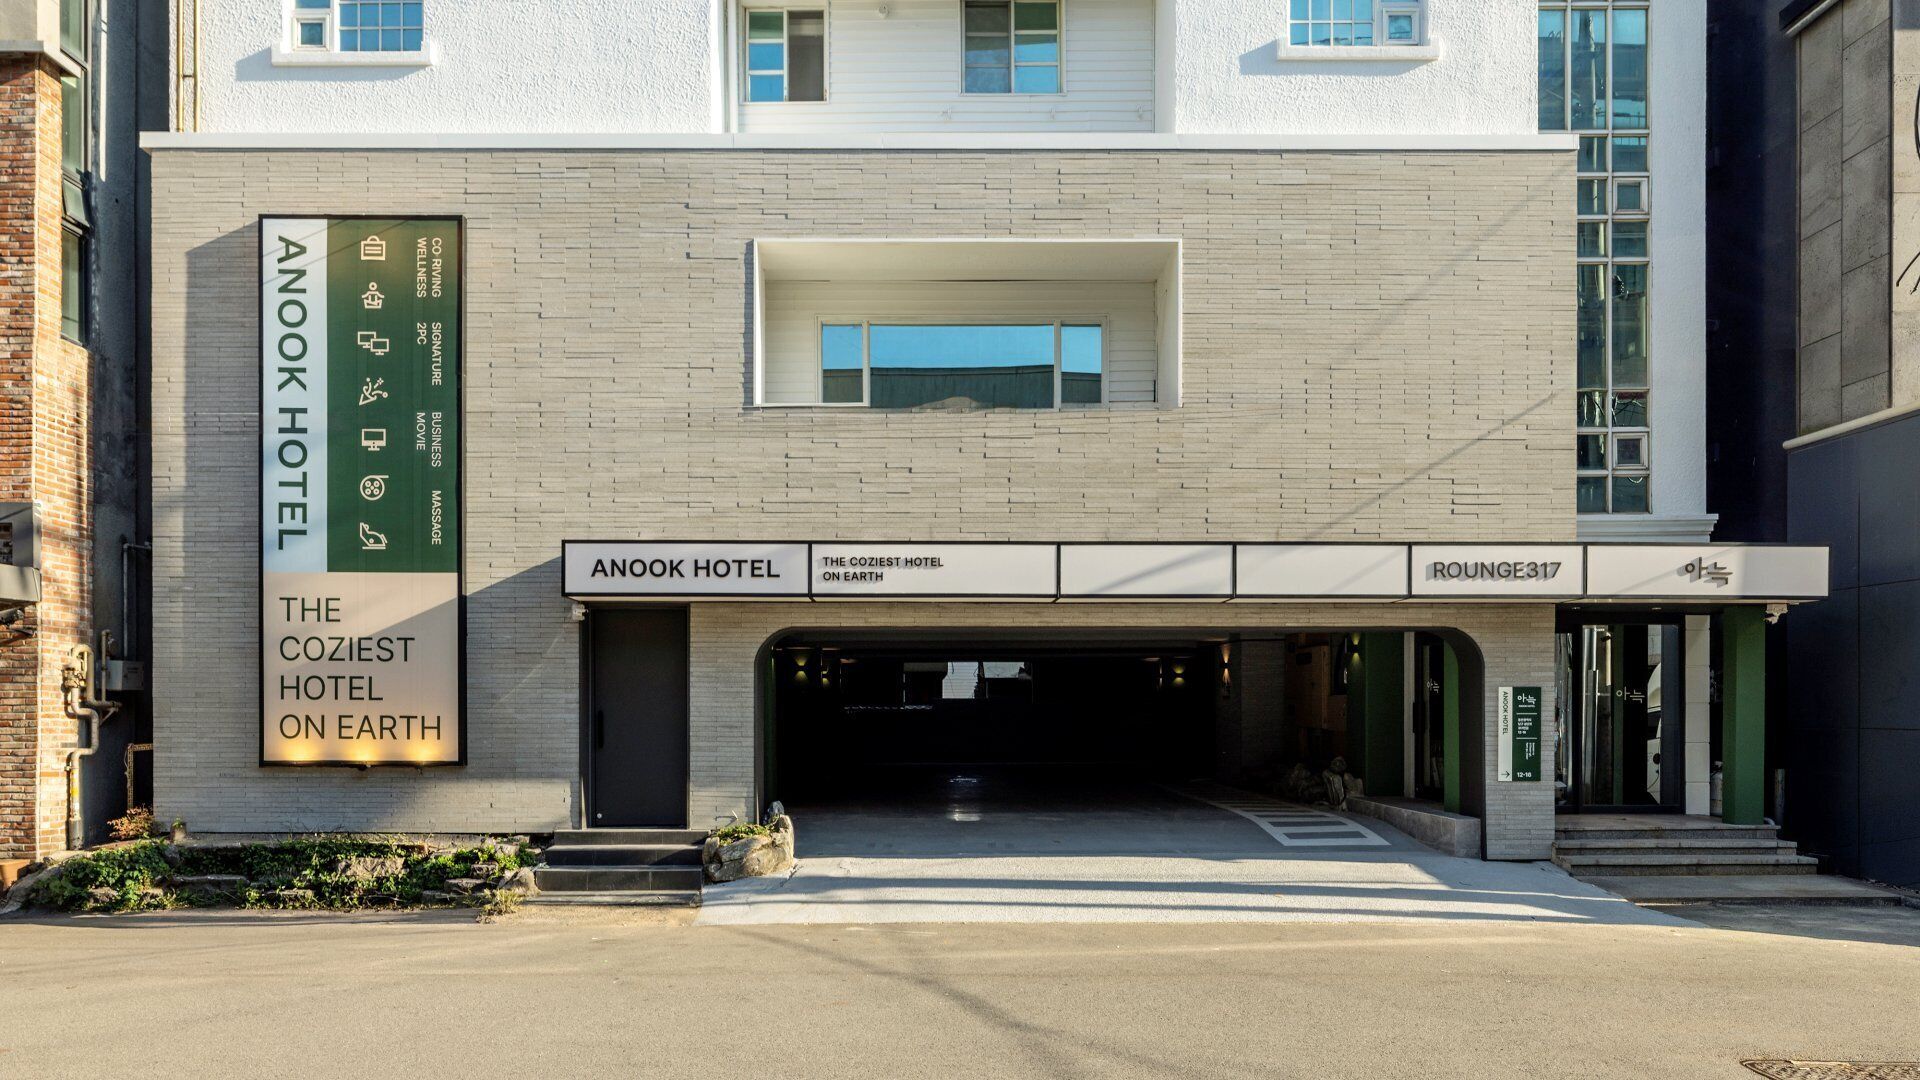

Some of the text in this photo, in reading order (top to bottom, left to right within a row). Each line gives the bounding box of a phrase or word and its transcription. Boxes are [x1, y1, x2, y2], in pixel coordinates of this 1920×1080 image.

[416, 237, 427, 298] WELLNESS
[416, 322, 427, 345] 2PC
[431, 322, 442, 386] SIGNATURE
[276, 235, 308, 551] ANOOK HOTEL
[416, 412, 426, 451] MOVIE
[431, 412, 442, 468] BUSINESS
[431, 490, 442, 545] MASSAGE
[590, 558, 781, 578] ANOOK HOTEL
[822, 556, 944, 567] THE COZIEST HOTEL
[1433, 561, 1562, 579] ROUNGE317
[1685, 556, 1733, 585] 아늑
[822, 571, 884, 581] ON EARTH
[279, 597, 341, 623] THE
[279, 635, 416, 663] COZIEST
[280, 675, 384, 701] HOTEL
[1517, 693, 1536, 704] 아늑
[1615, 686, 1645, 704] 아늑
[279, 713, 441, 740] ON EARTH
